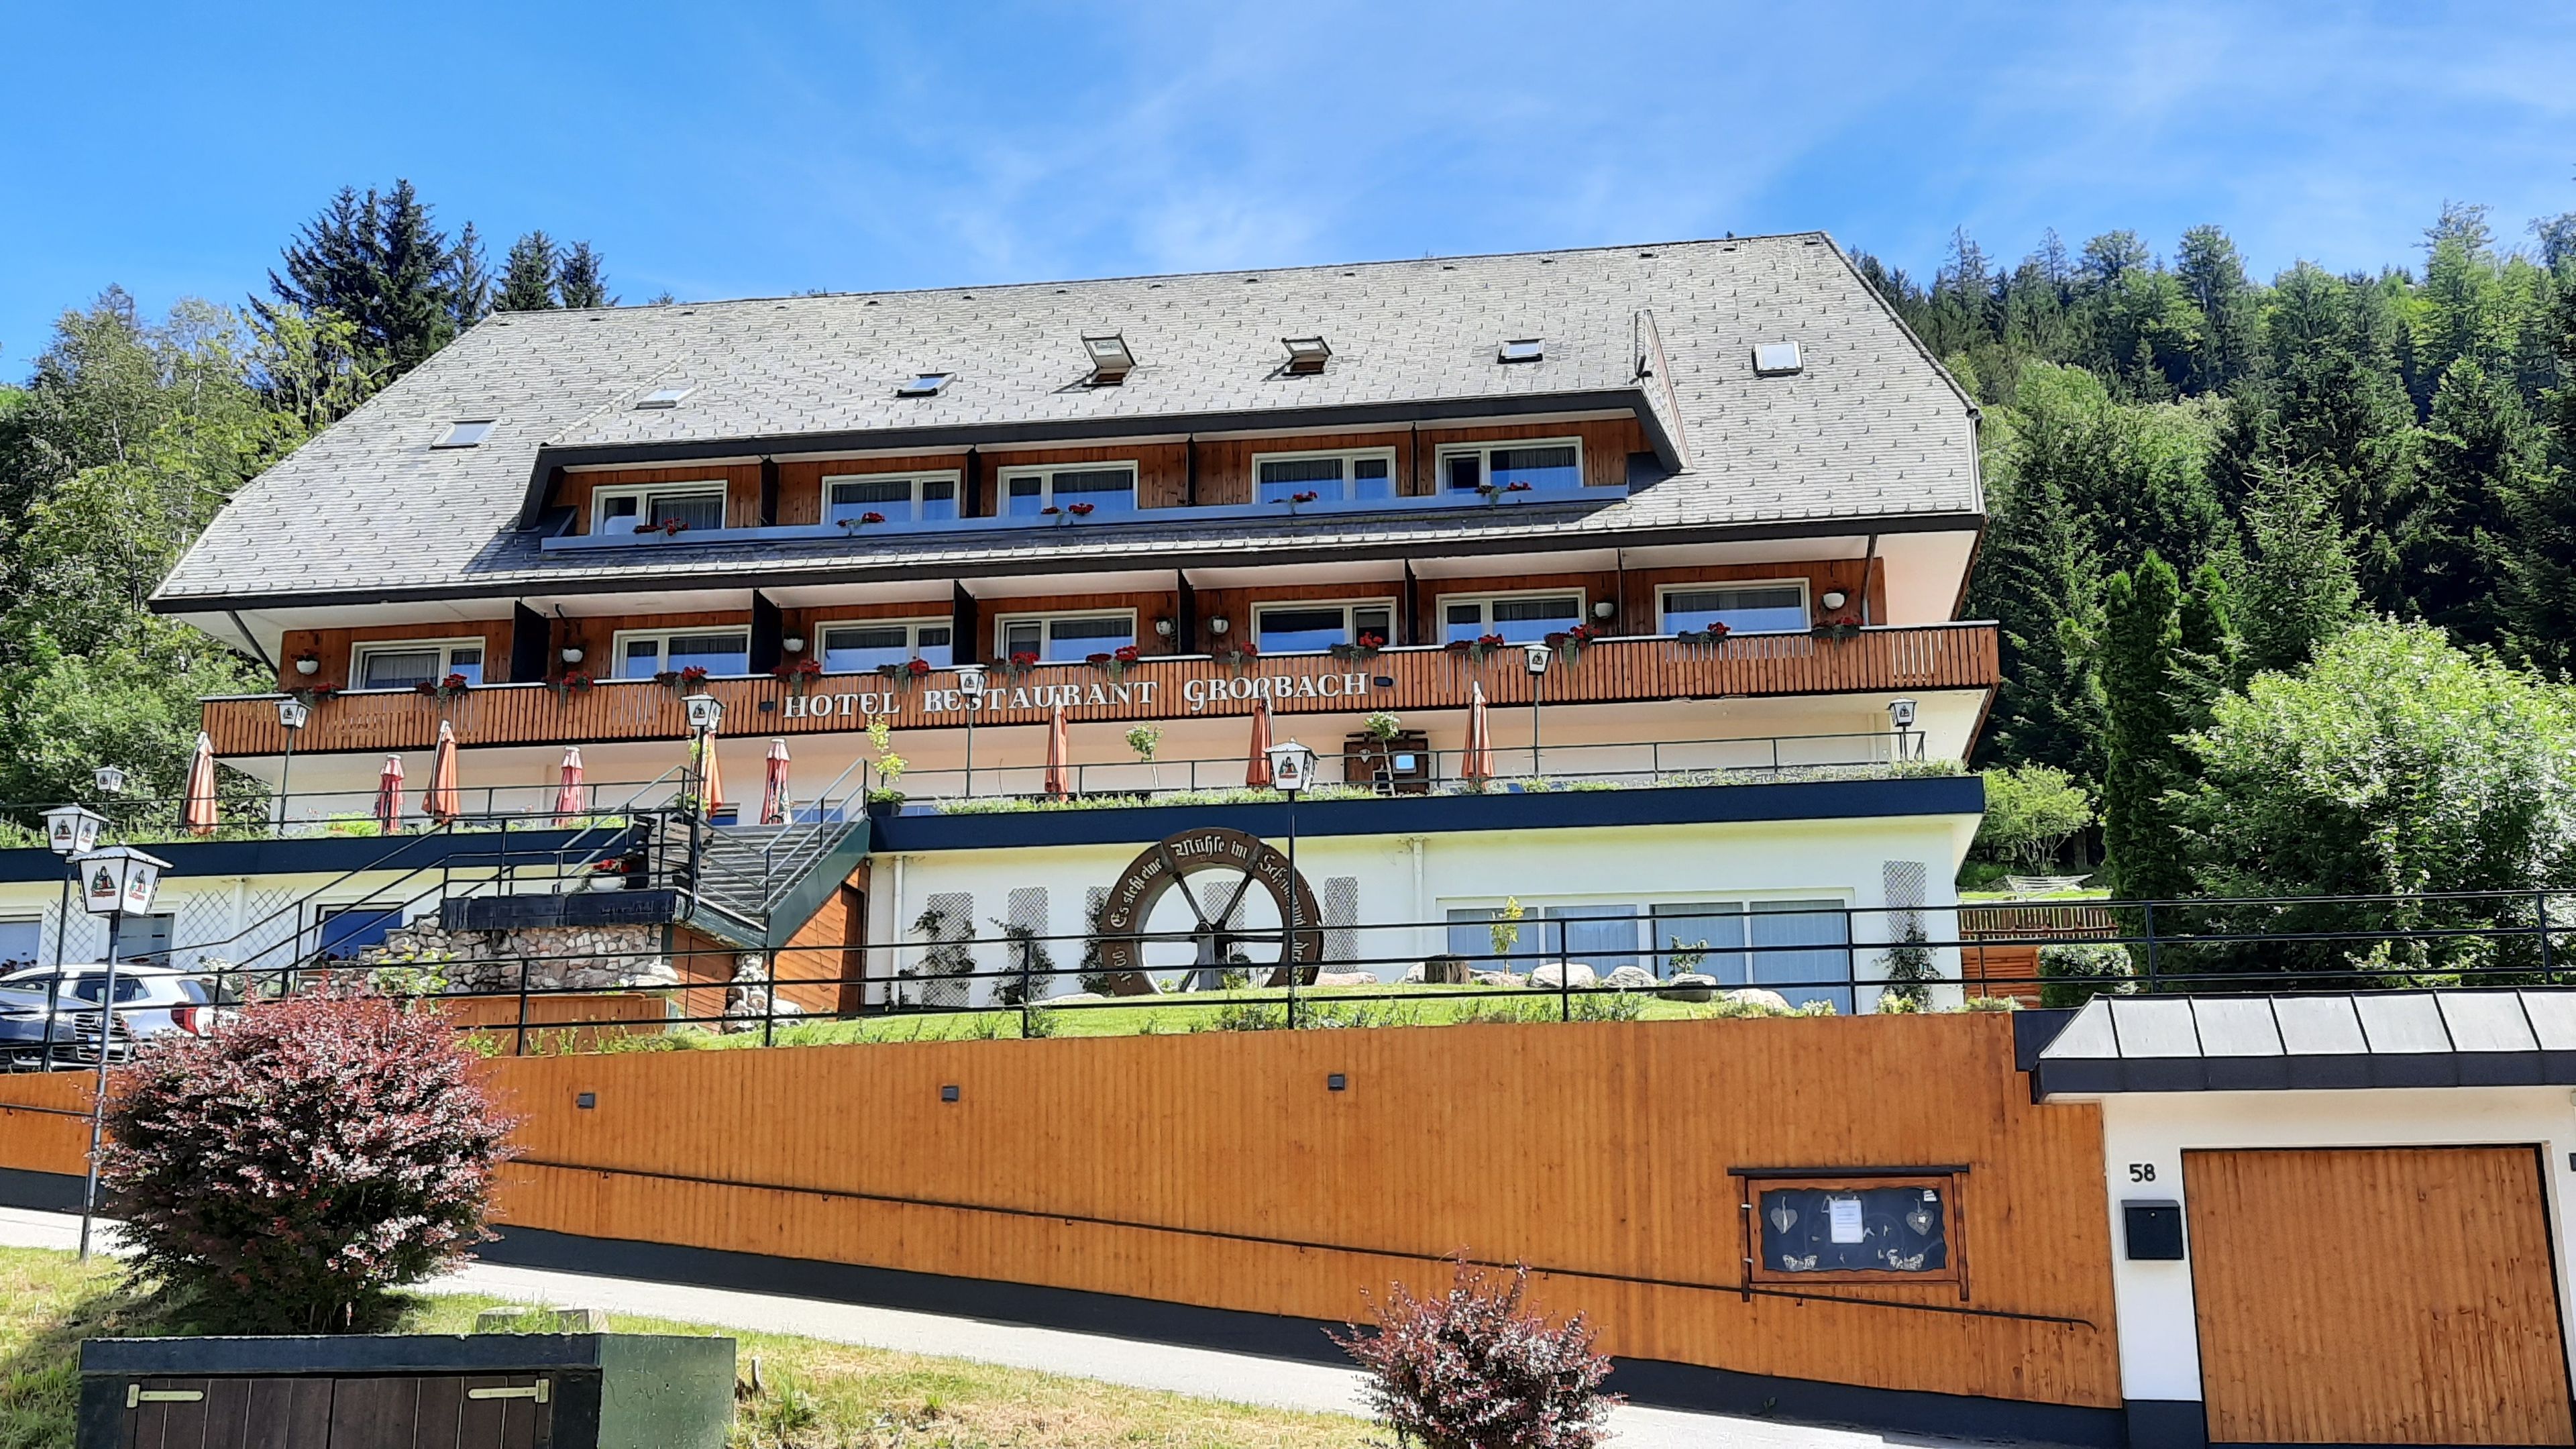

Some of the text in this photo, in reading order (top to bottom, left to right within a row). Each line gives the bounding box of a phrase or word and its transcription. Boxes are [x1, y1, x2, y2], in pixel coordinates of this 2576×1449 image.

[784, 692, 901, 718] HOTEL
[922, 682, 1159, 713] RESTAURANT
[1110, 907, 1130, 928] Es
[1141, 857, 1163, 879] eine
[1169, 835, 1226, 857] Mühle
[1230, 841, 1248, 859] im
[2129, 1163, 2157, 1183] 58
